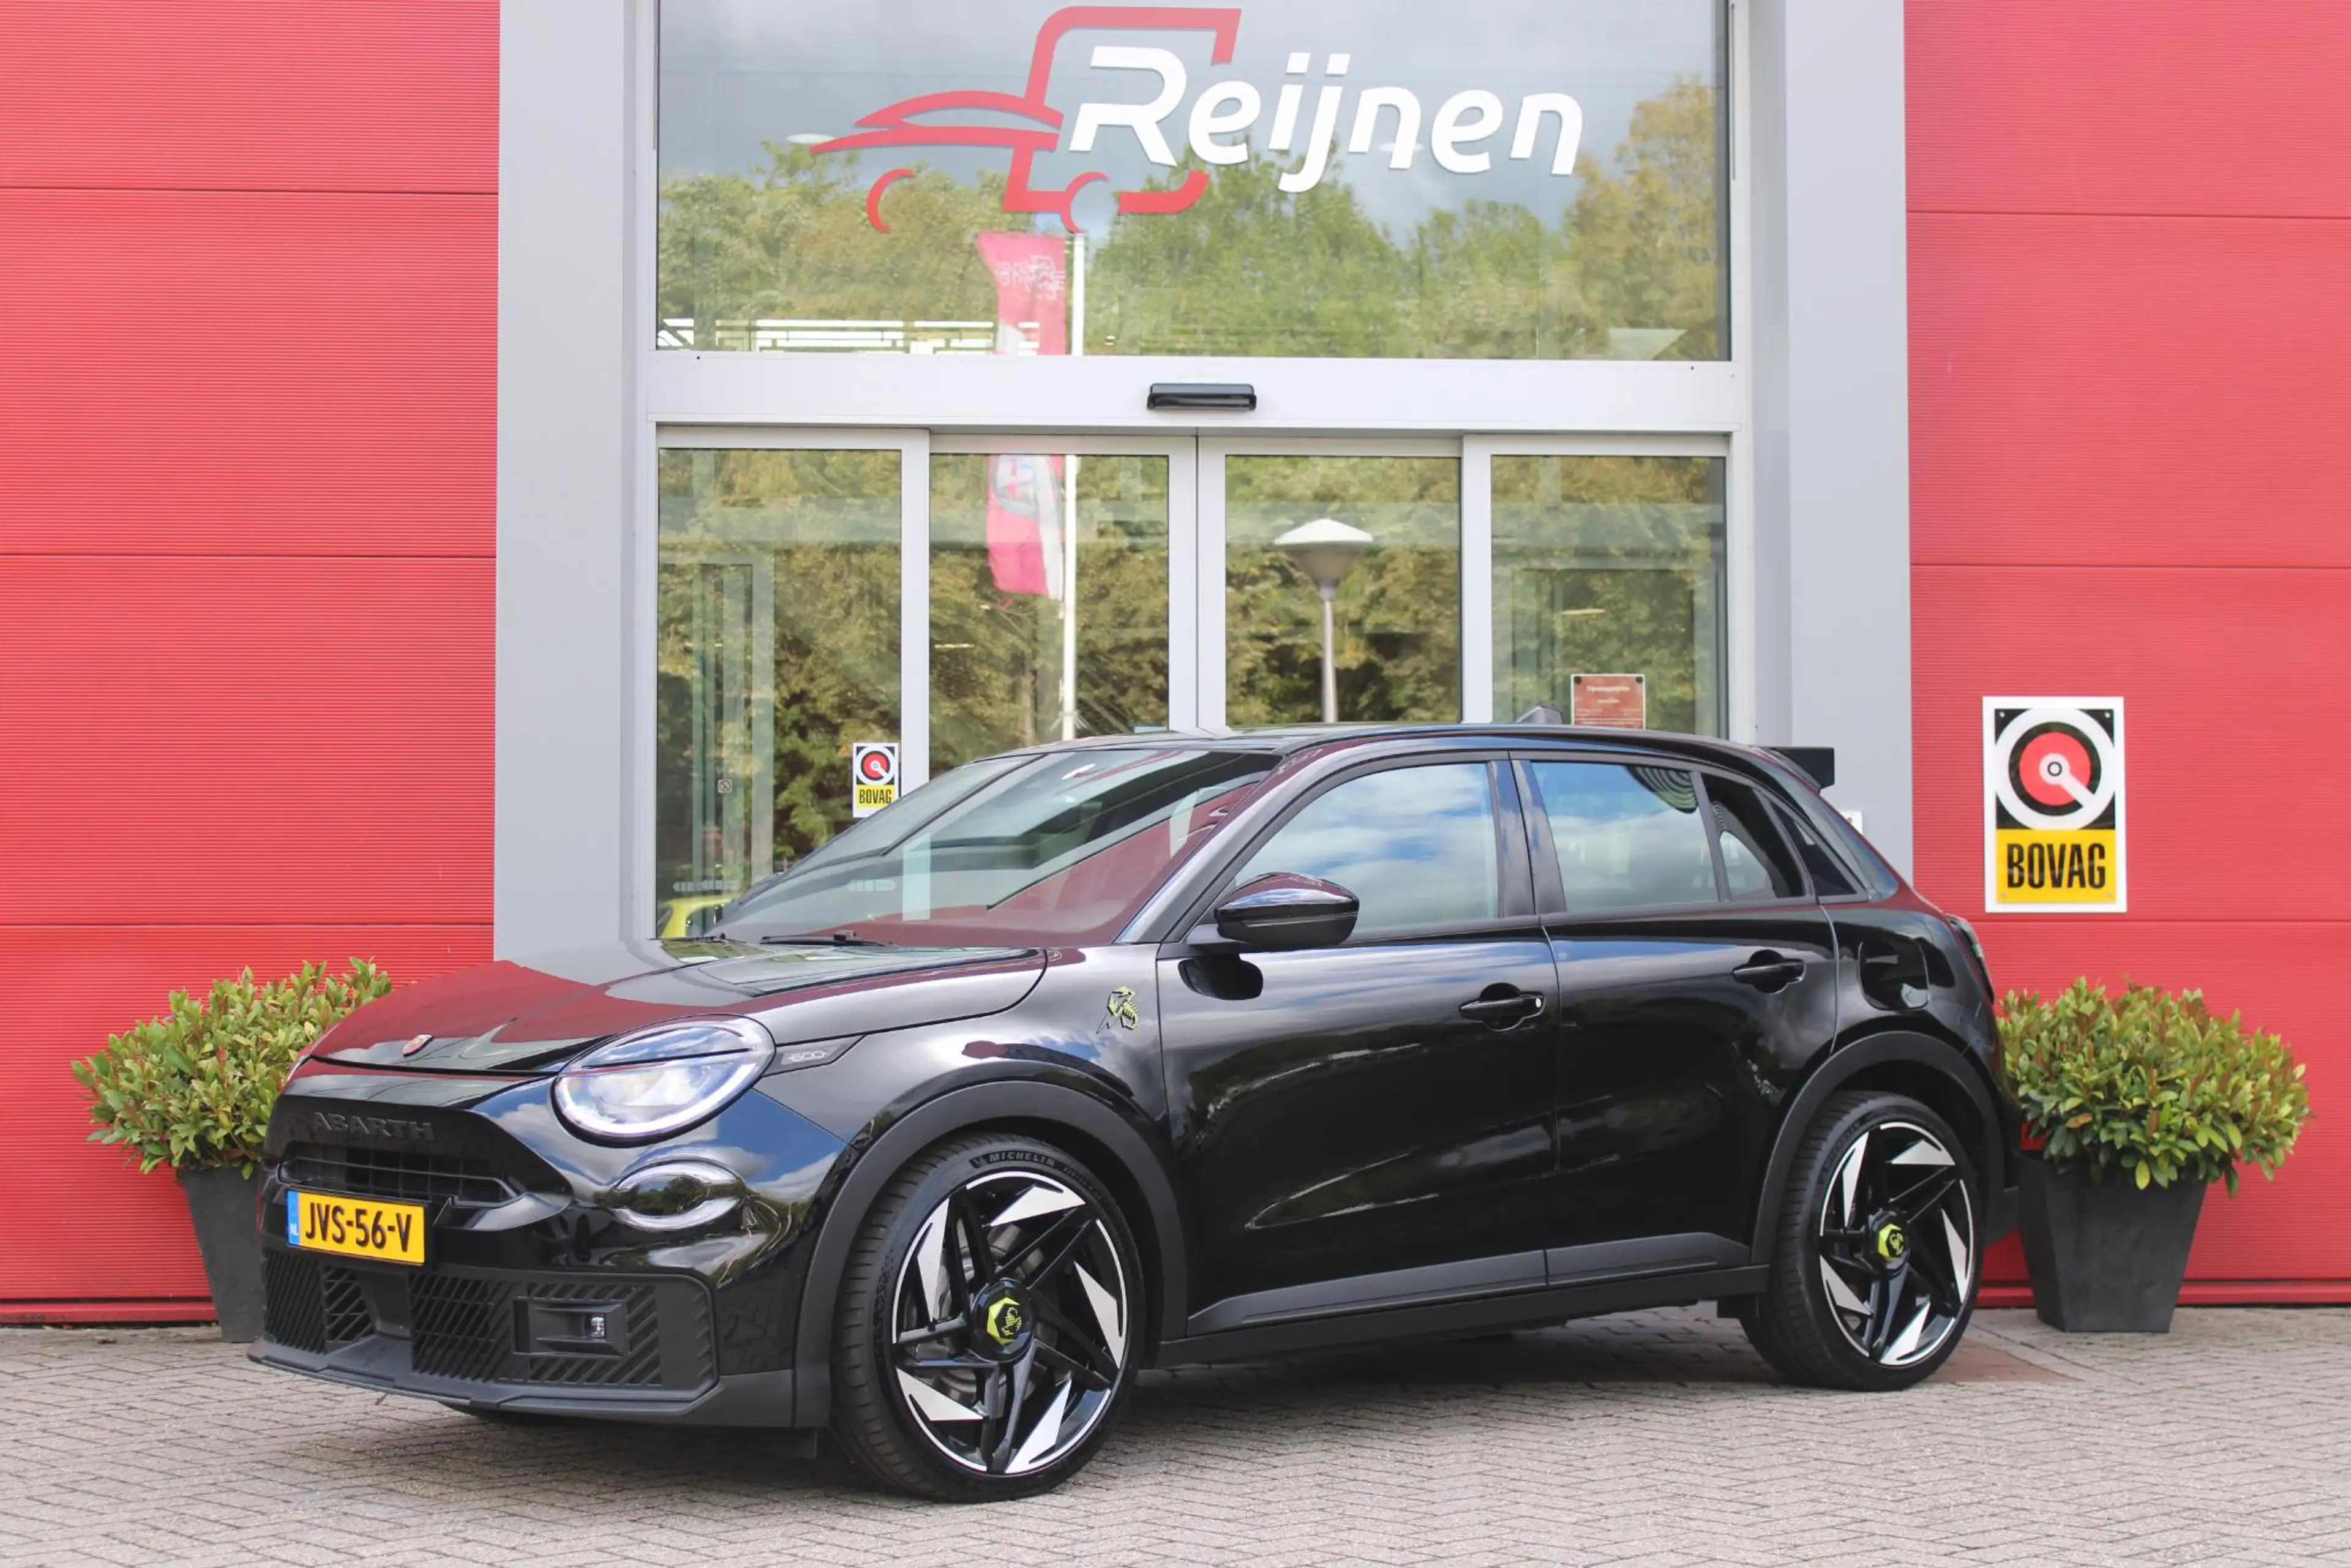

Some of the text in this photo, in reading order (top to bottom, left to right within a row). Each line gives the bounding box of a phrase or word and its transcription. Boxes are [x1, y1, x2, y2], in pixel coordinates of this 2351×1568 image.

[1069, 46, 1583, 193] Reijnen
[859, 788, 892, 805] BOVAG
[2006, 842, 2106, 890] BOVAG
[313, 1112, 435, 1141] ABARTH
[989, 1151, 1055, 1167] MICHELIN
[306, 1202, 412, 1253] JVS-56-V
